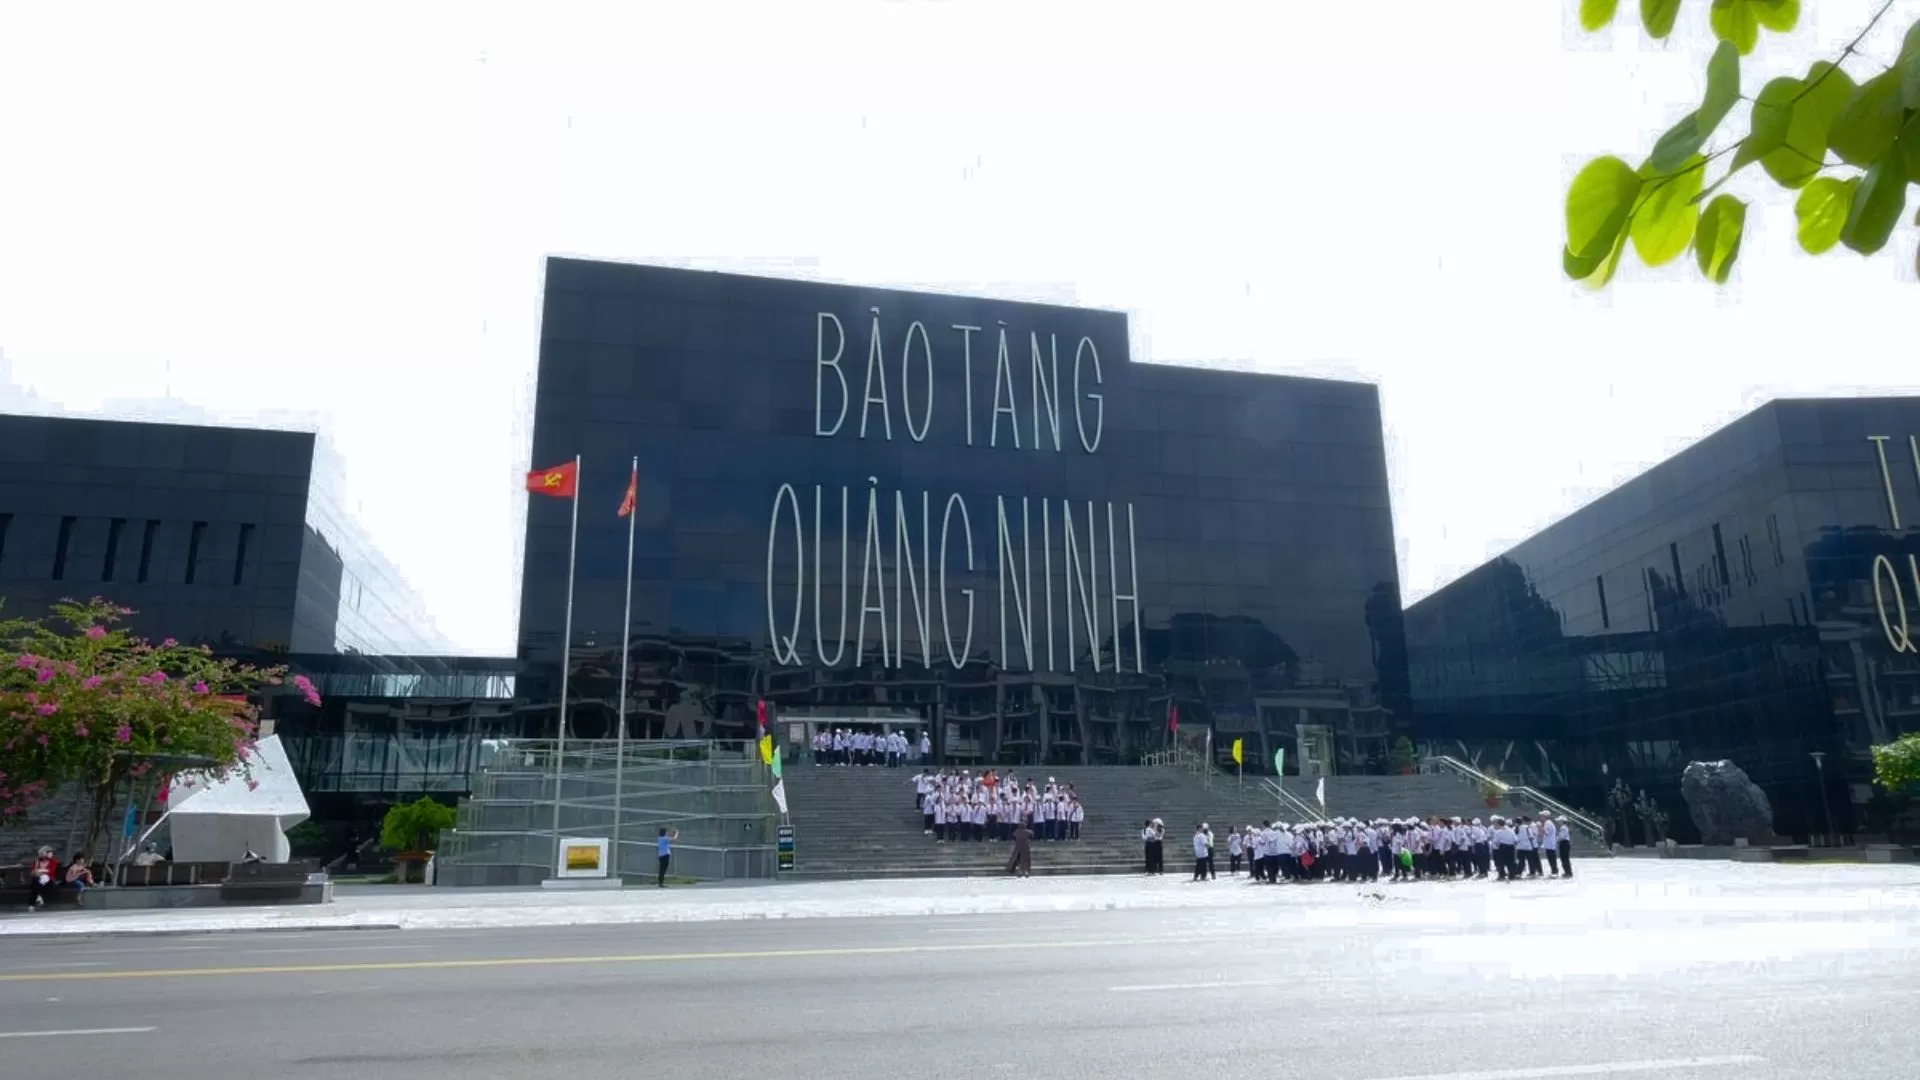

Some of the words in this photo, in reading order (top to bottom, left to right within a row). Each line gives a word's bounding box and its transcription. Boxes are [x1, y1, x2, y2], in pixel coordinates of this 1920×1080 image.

[815, 306, 934, 442] BẢO
[952, 320, 1104, 453] TÀNG
[767, 476, 974, 670] QUẢNG
[998, 495, 1143, 674] NINH
